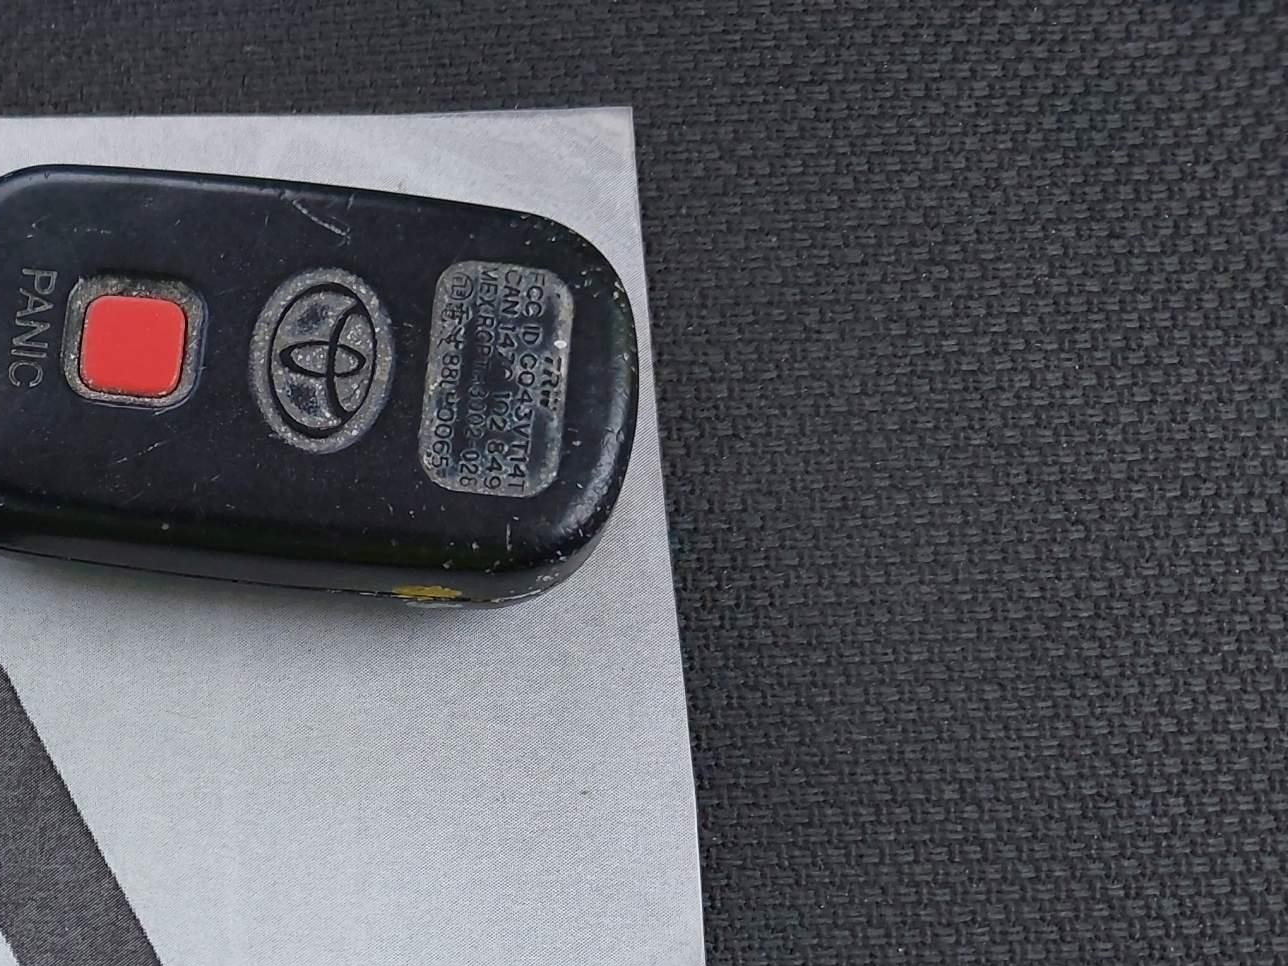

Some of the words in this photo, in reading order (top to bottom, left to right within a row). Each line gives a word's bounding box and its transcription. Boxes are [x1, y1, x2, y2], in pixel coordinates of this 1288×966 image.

[501, 268, 524, 316] CAN
[525, 271, 548, 319] FCC
[8, 267, 58, 388] PANIC
[522, 325, 541, 345] ID
[482, 439, 506, 491] 849
